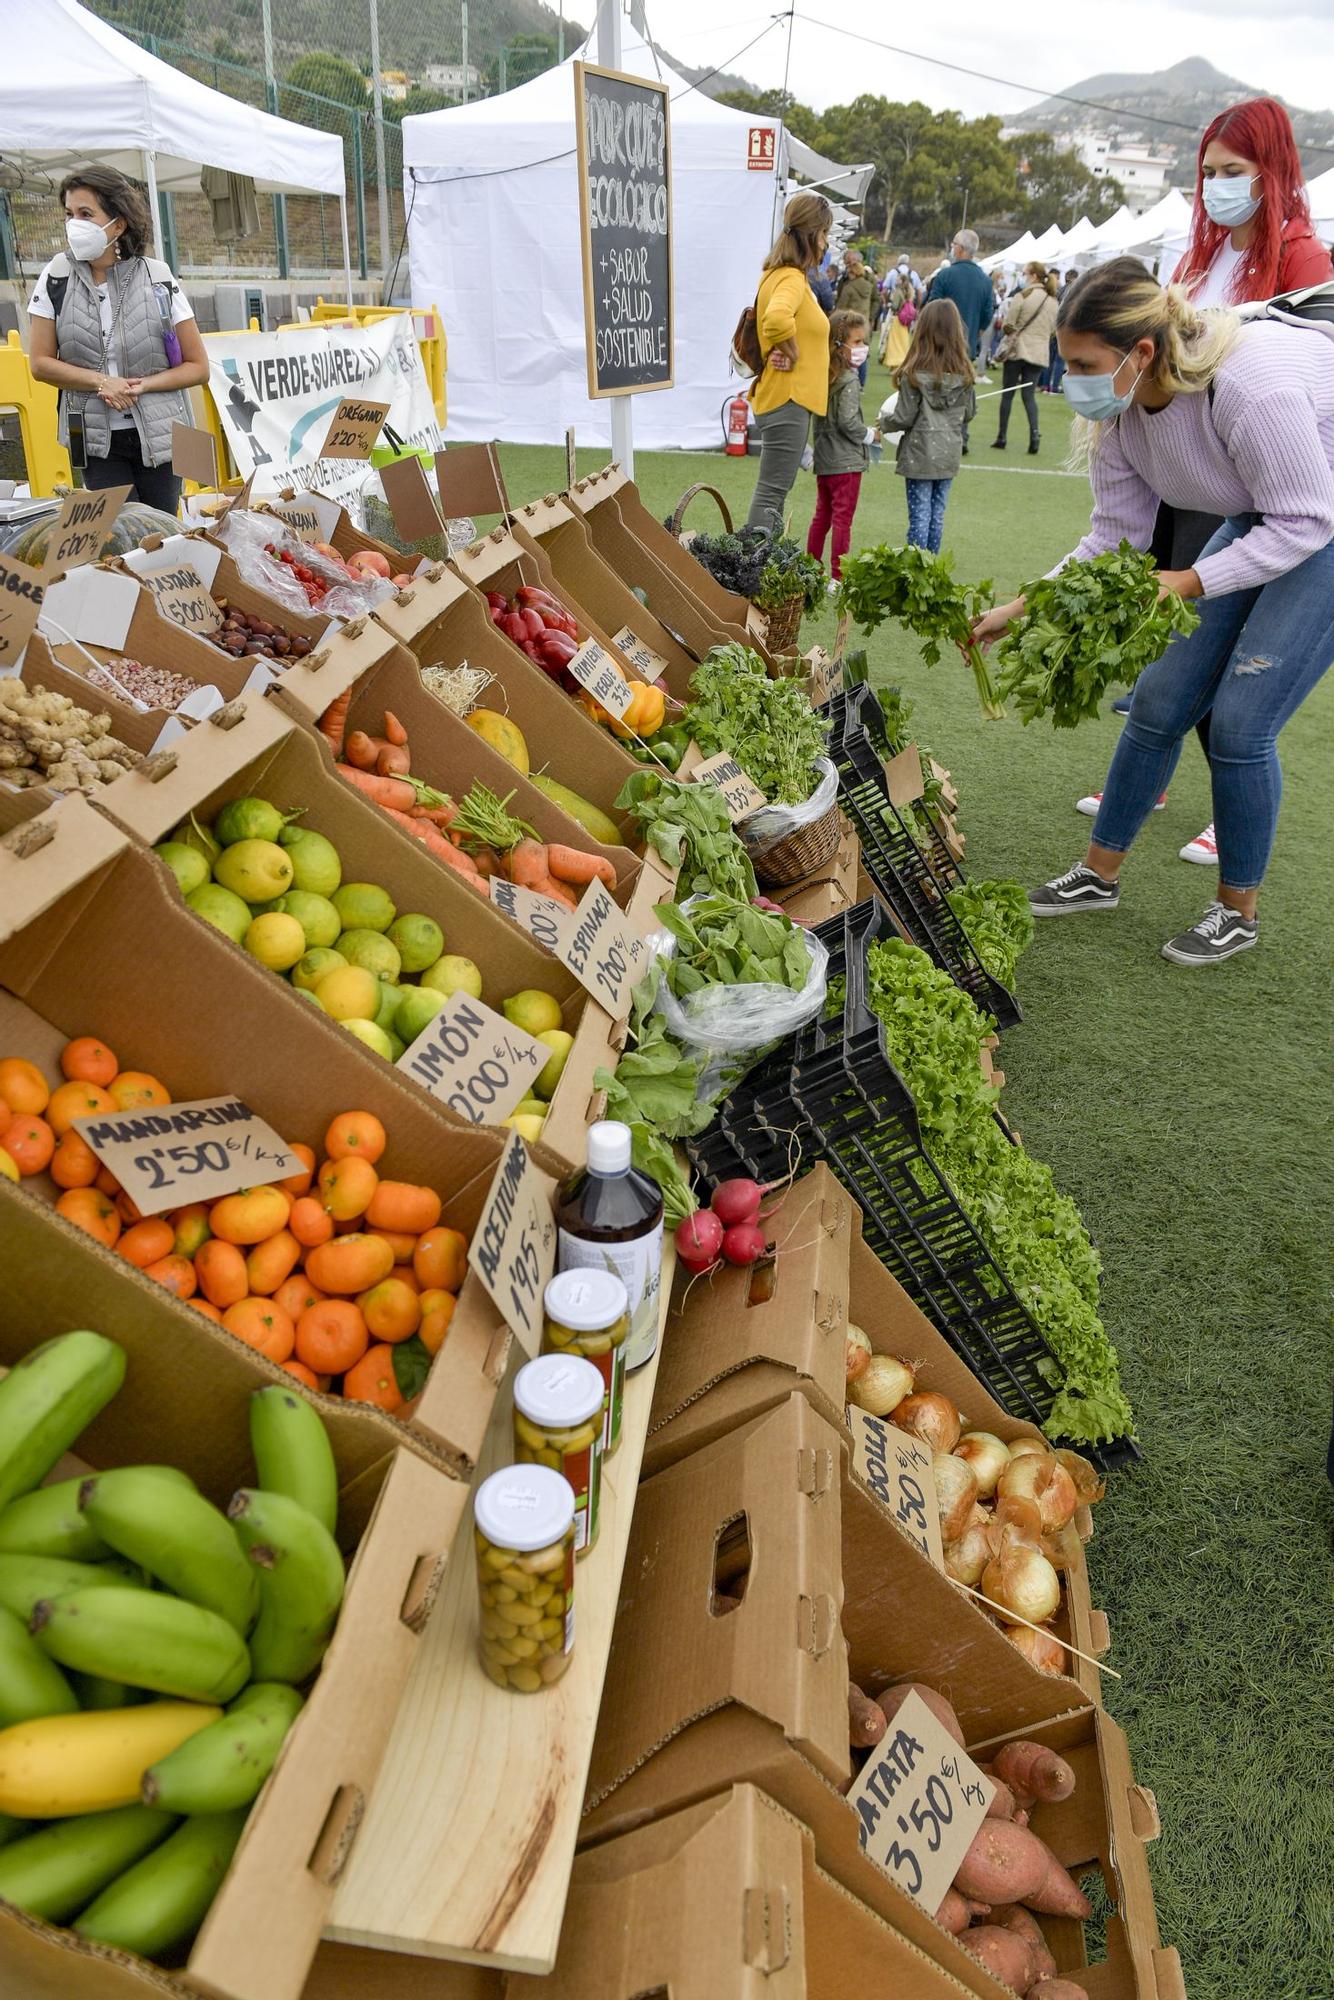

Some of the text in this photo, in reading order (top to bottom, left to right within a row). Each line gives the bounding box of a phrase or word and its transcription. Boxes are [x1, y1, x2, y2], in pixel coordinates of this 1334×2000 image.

[596, 326, 667, 371] SOSTENIBLE
[63, 493, 106, 528] JUDÍA
[592, 667, 617, 701] VERDE
[567, 893, 612, 975] ESPINACA
[411, 1003, 485, 1090] IMÓN
[87, 1102, 256, 1149] MANDARINA
